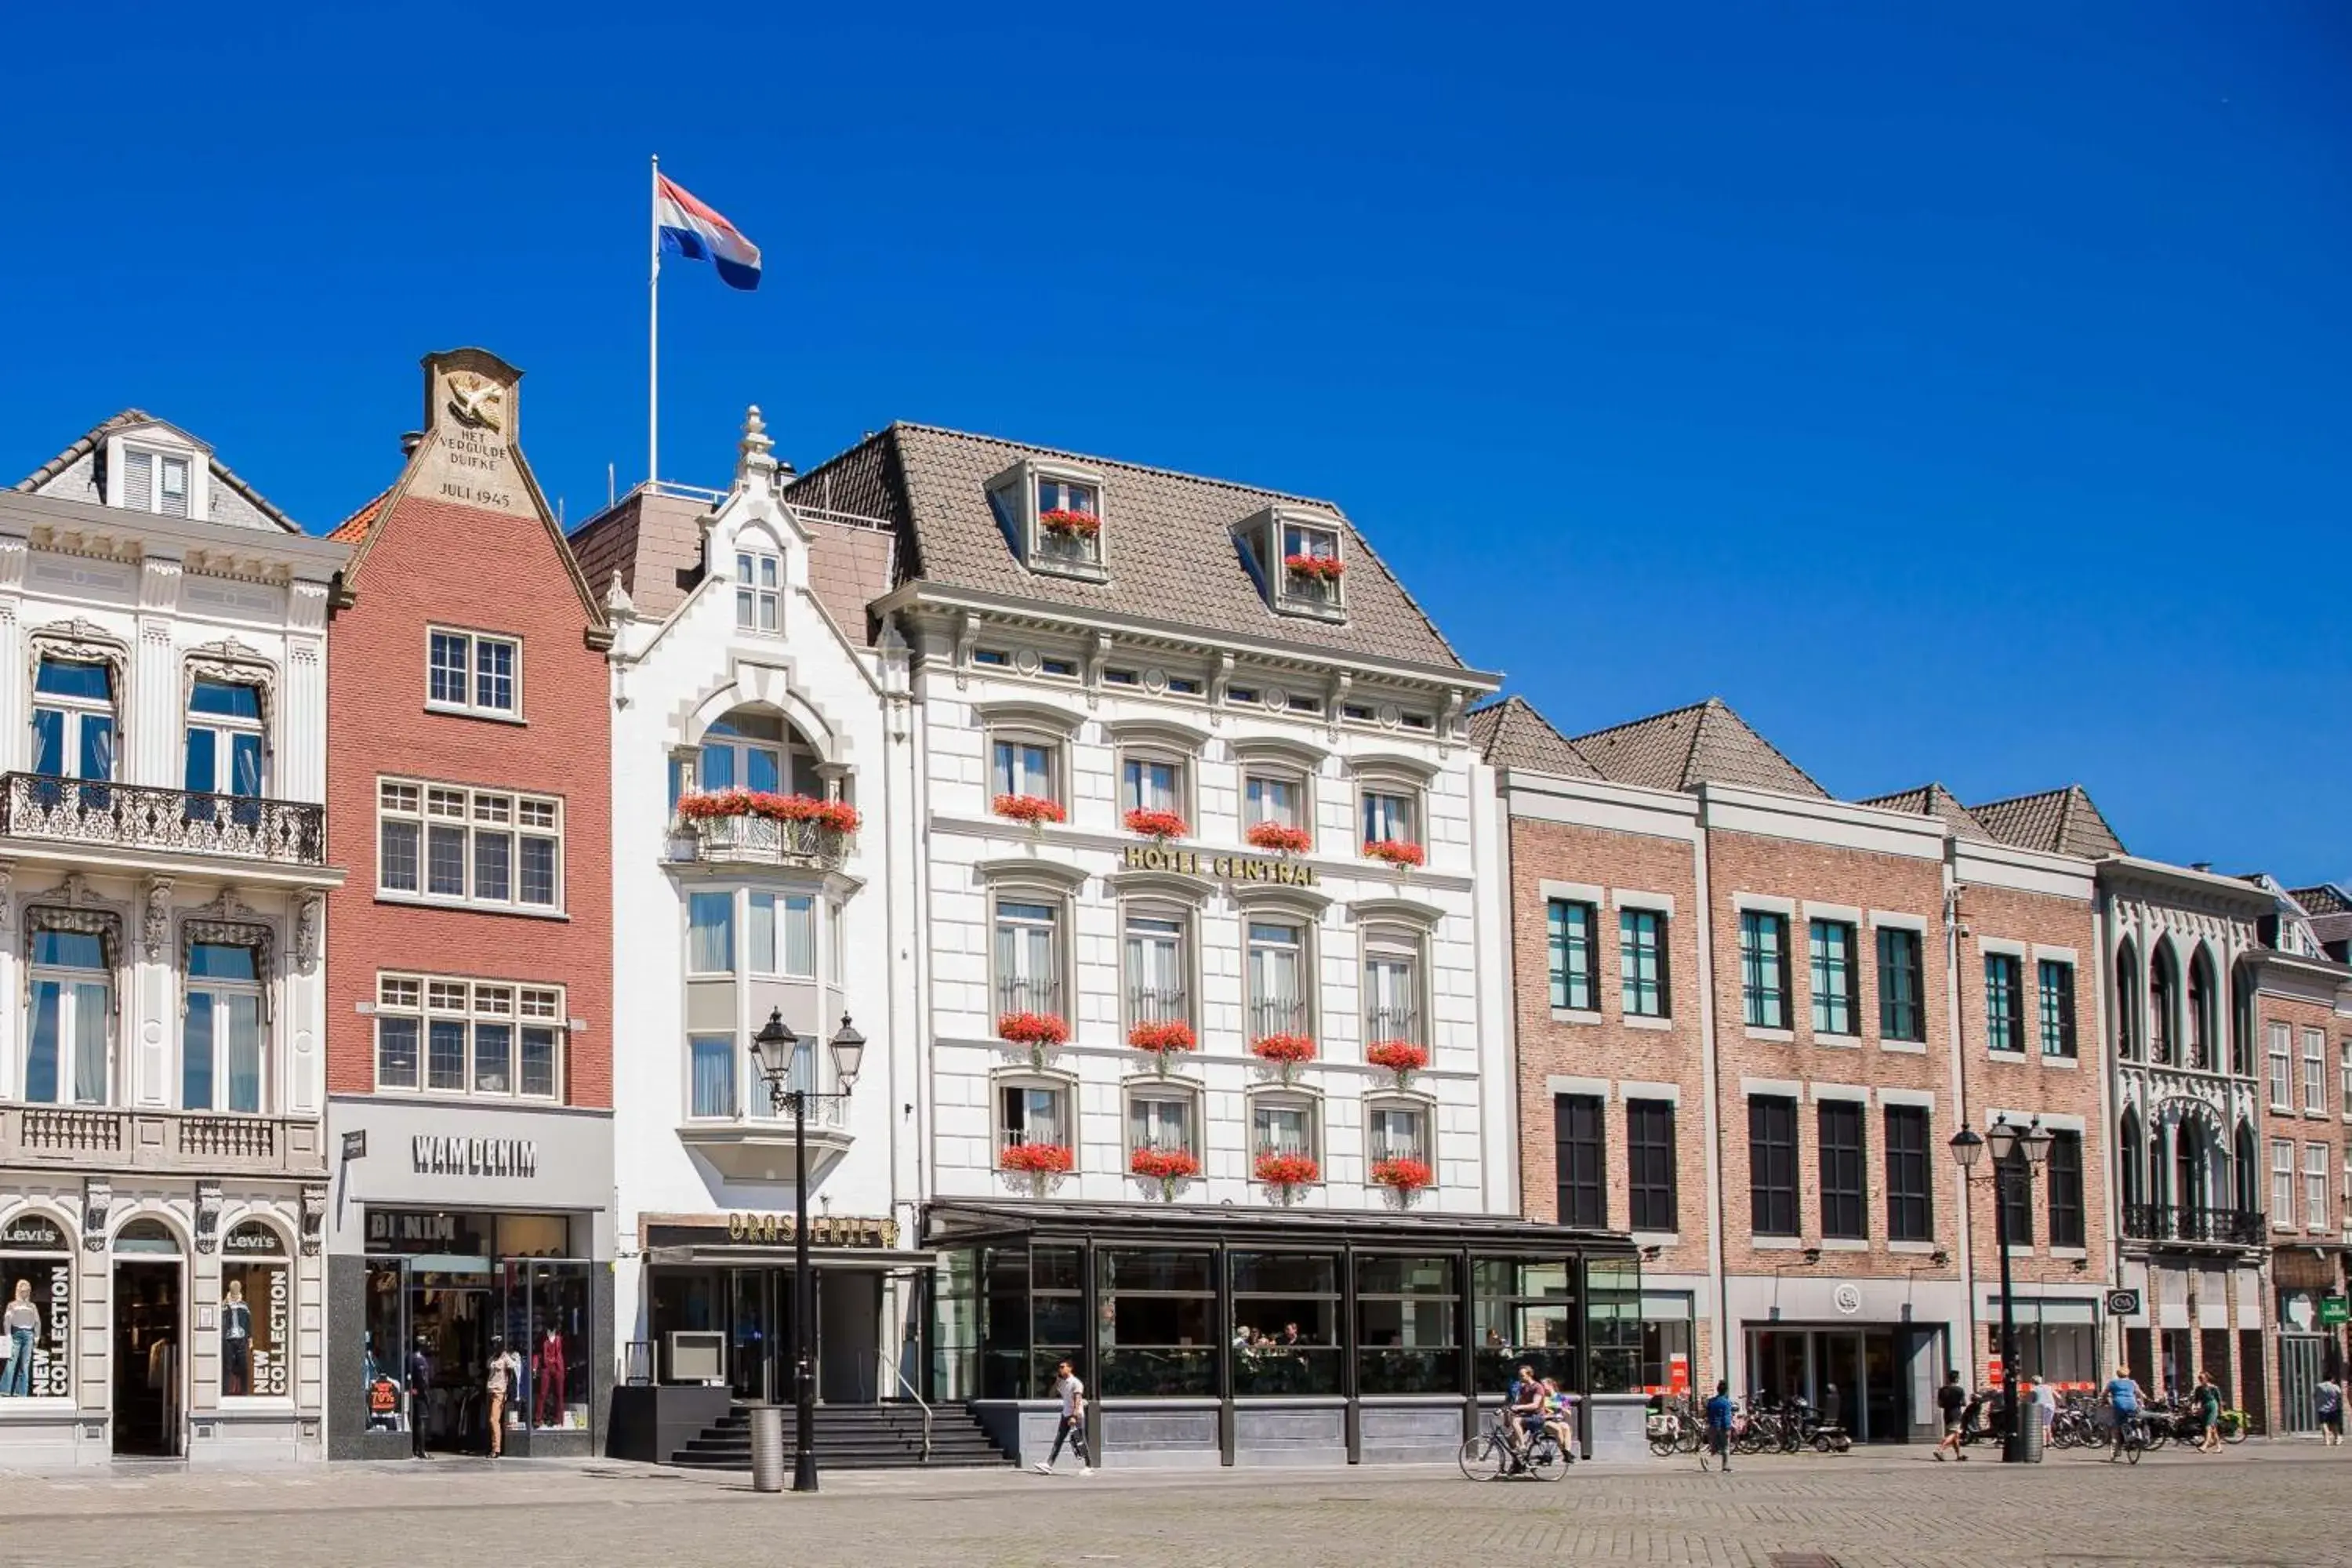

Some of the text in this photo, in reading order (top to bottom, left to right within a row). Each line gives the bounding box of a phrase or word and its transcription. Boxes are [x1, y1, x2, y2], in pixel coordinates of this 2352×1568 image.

[461, 429, 485, 444] HET
[450, 452, 498, 471] DUIFKE
[438, 483, 510, 509] JULI 1945
[1123, 846, 1321, 887] HOTEL CENTRAL
[412, 1135, 539, 1172] WAM DENIM
[728, 1212, 872, 1246] BRASERIE
[51, 1266, 69, 1396] COLLECTION
[270, 1271, 287, 1395] COLLECTION
[33, 1348, 49, 1396] NEW
[253, 1349, 270, 1394] NEW
